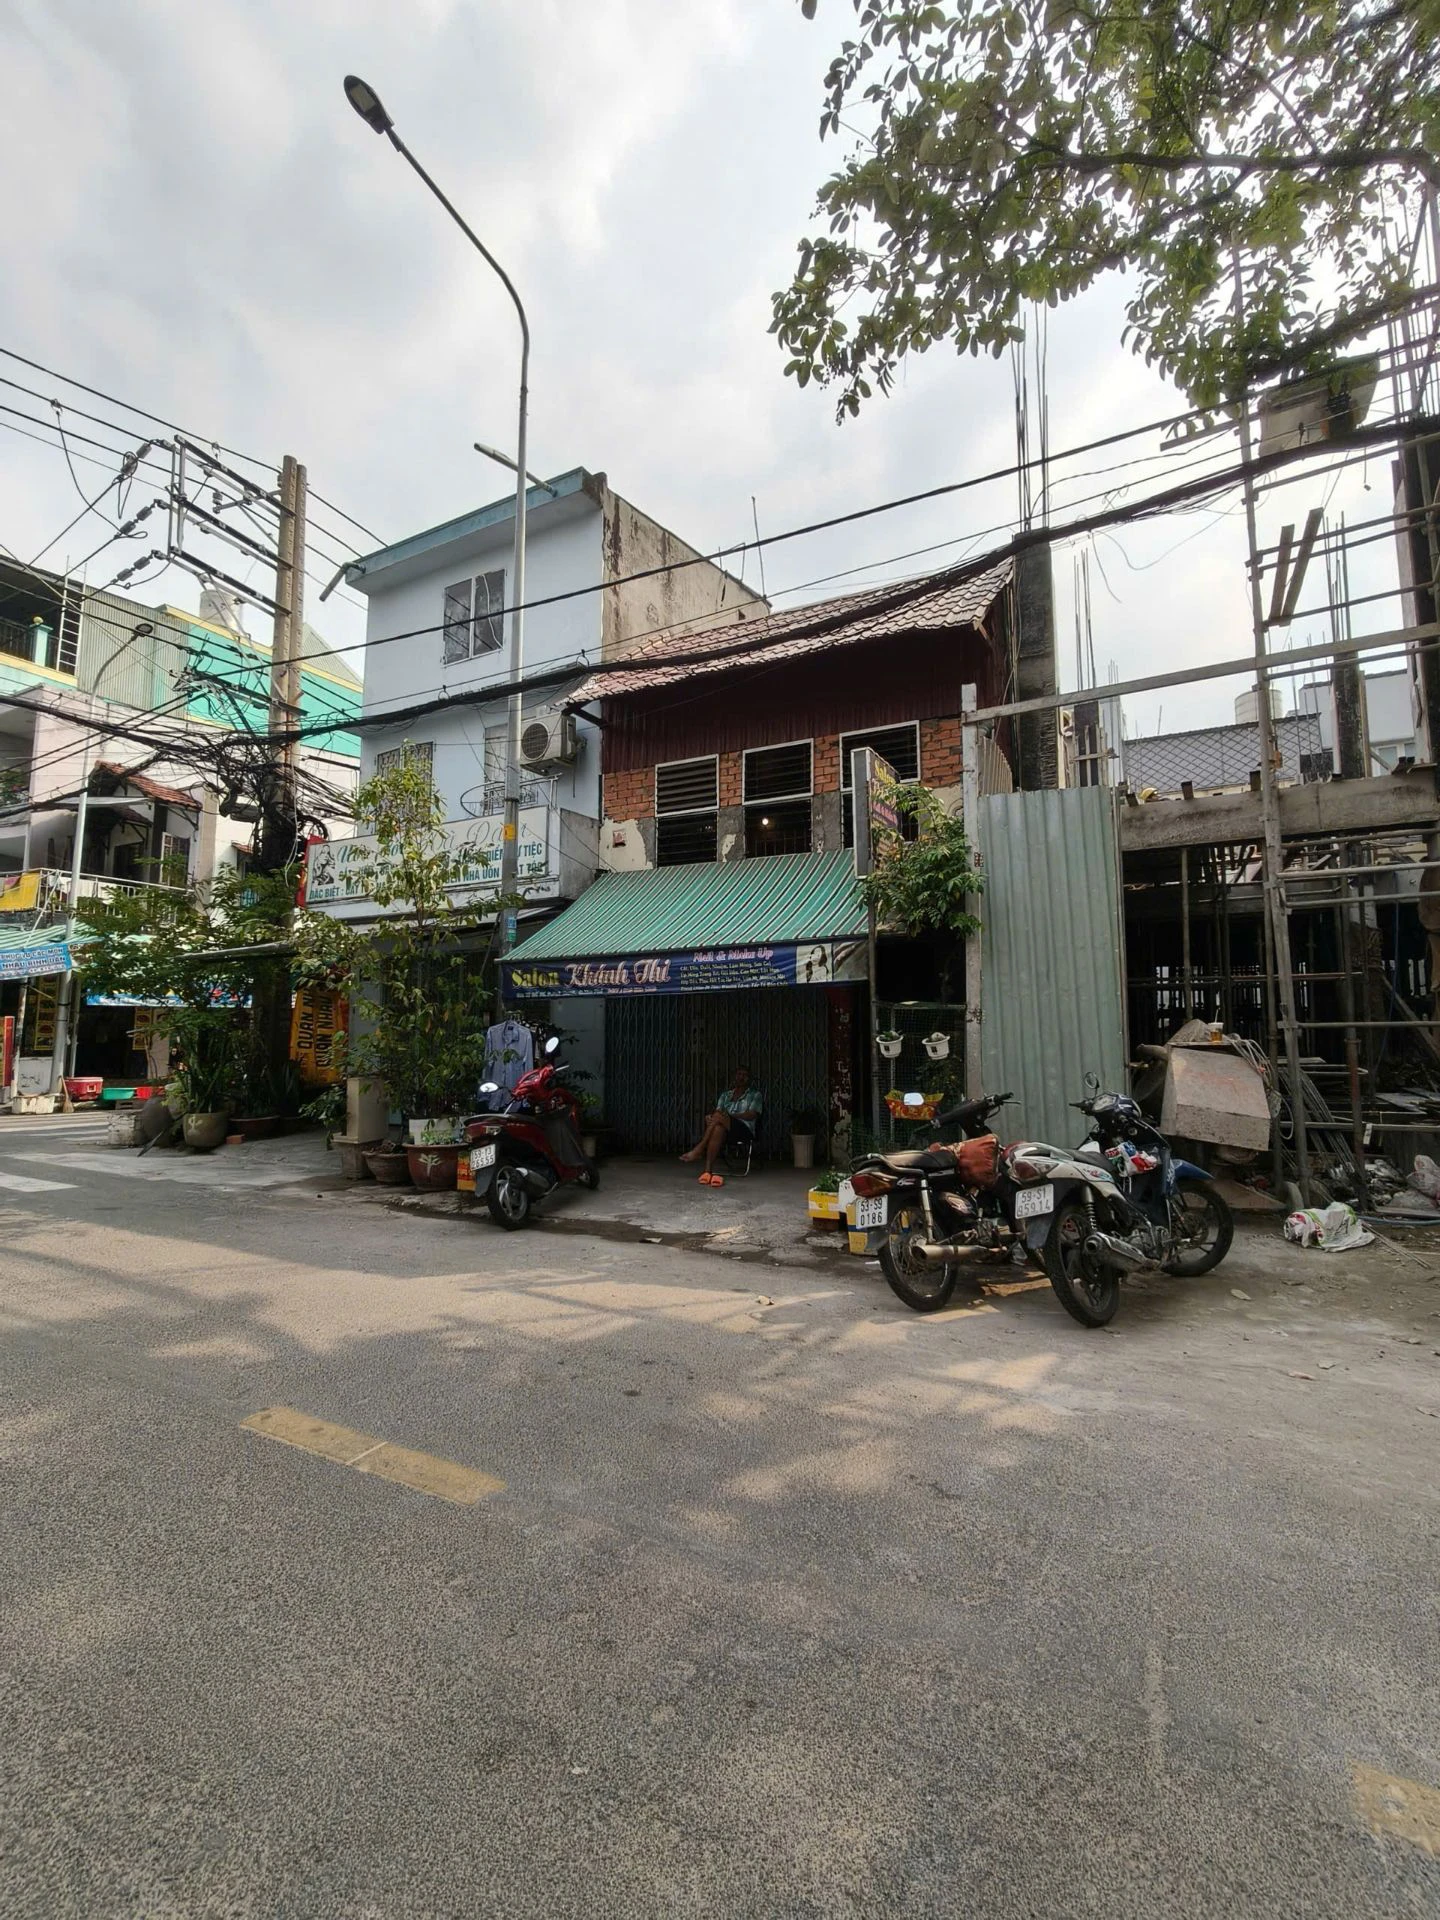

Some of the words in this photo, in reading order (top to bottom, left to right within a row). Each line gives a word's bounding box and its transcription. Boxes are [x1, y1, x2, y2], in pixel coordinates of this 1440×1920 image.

[523, 841, 543, 858] TIỆC
[511, 967, 560, 988] Salon
[563, 961, 631, 989] Khánh
[633, 958, 672, 984] Thi
[861, 1198, 883, 1212] 53-S9
[860, 1211, 883, 1226] 0186
